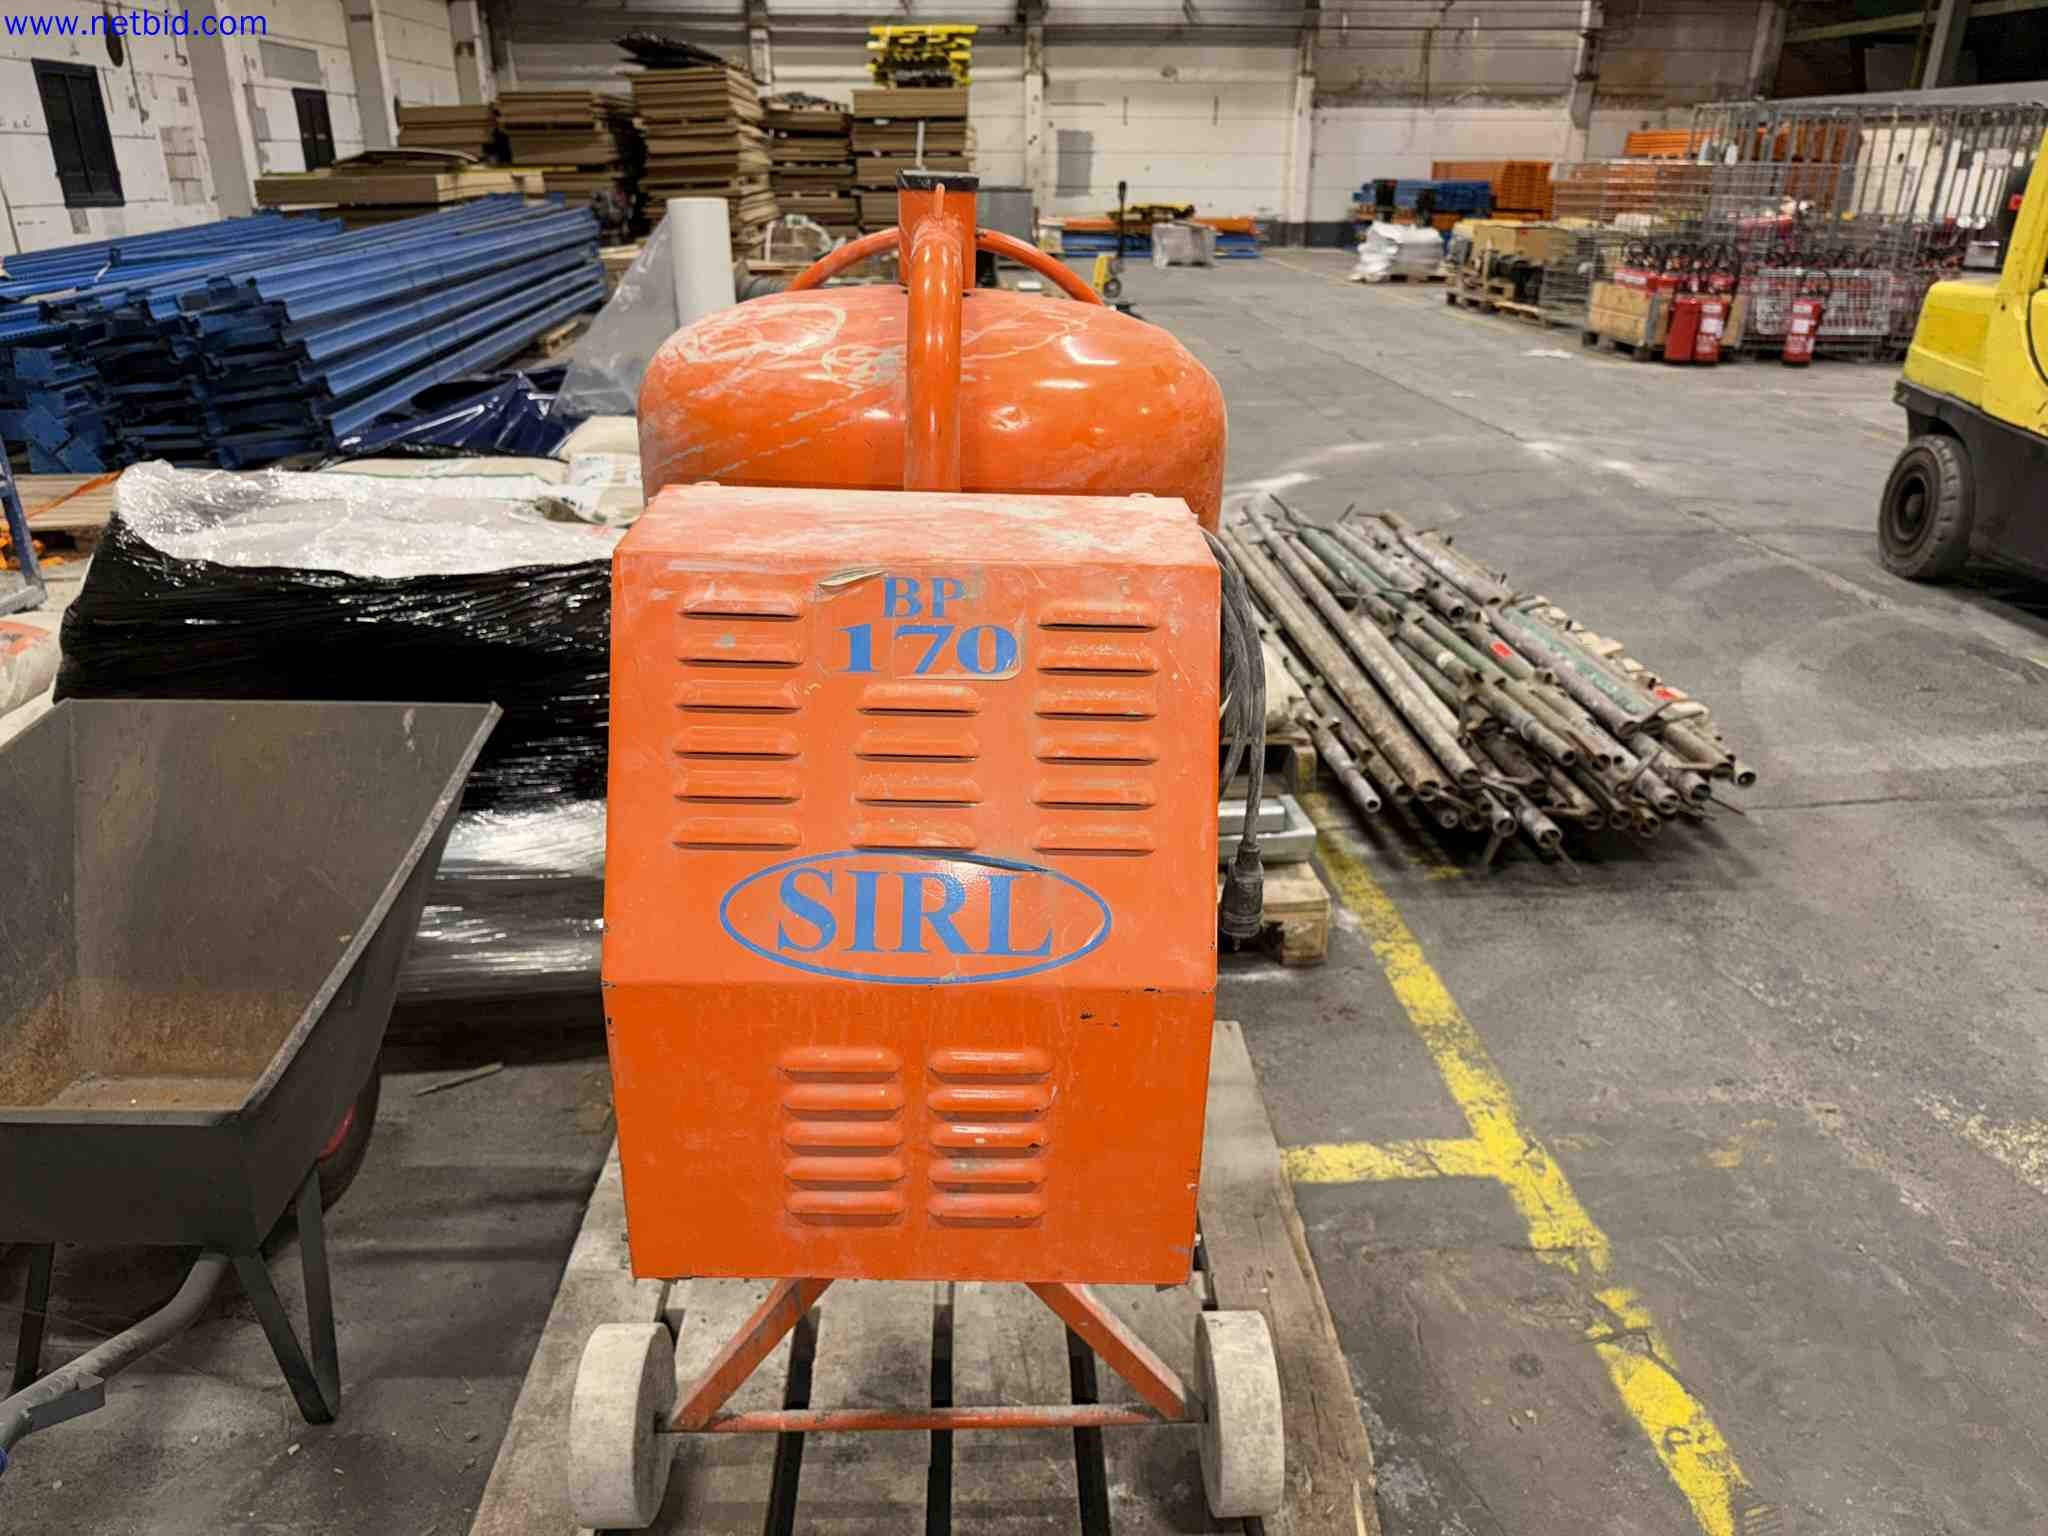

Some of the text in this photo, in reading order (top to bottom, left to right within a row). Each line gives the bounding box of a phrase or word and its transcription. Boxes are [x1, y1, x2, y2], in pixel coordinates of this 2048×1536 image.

[882, 577, 966, 617] BP
[841, 624, 1017, 674] 170
[778, 869, 1053, 957] SIRL
